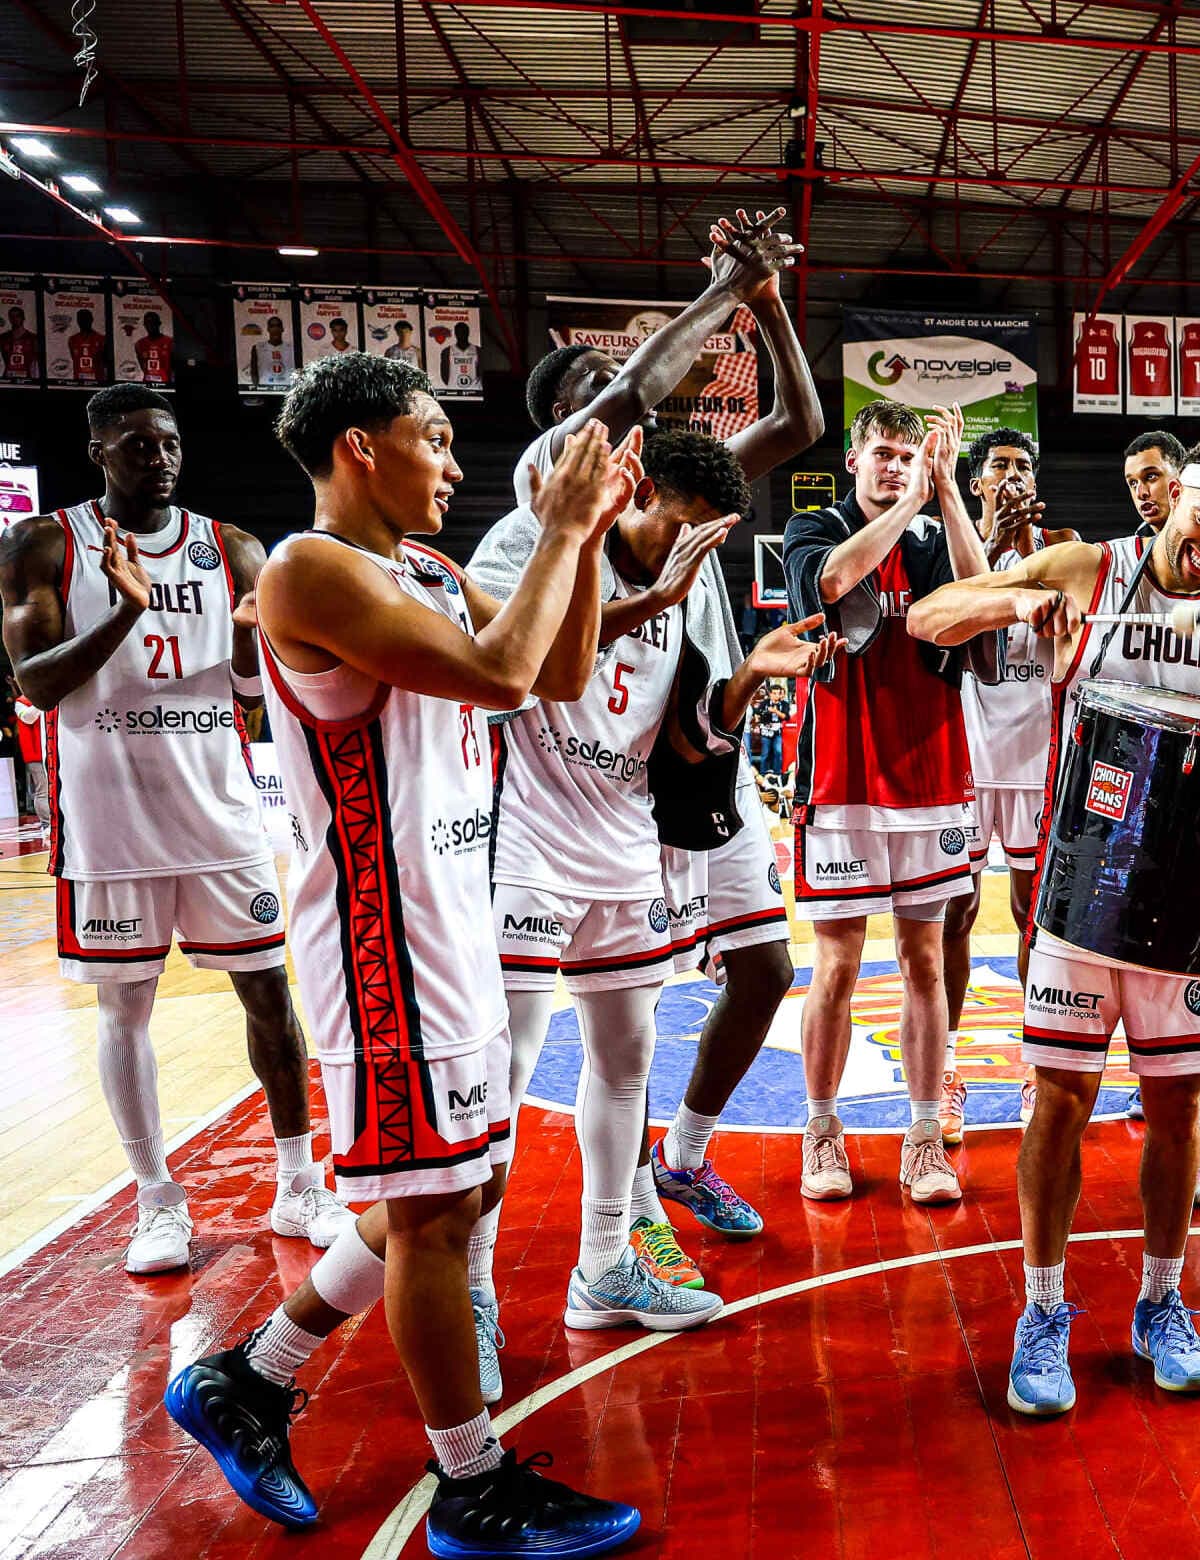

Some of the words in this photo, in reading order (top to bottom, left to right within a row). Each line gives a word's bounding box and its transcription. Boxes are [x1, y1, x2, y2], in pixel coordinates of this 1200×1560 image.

[575, 331, 640, 347] SAVEURS
[913, 357, 1012, 376] novelgie
[1089, 358, 1106, 381] 10
[1145, 360, 1156, 382] 4
[143, 633, 184, 680] 21
[1005, 660, 1045, 682] ngie
[607, 662, 636, 716] 5
[126, 704, 233, 733] solengie
[1094, 767, 1129, 790] CHOLET
[1090, 786, 1123, 809] FANS
[816, 859, 868, 874] MILLET
[501, 931, 538, 943] Fenêtres
[1030, 983, 1105, 1010] MILLET
[1058, 1007, 1067, 1016] et
